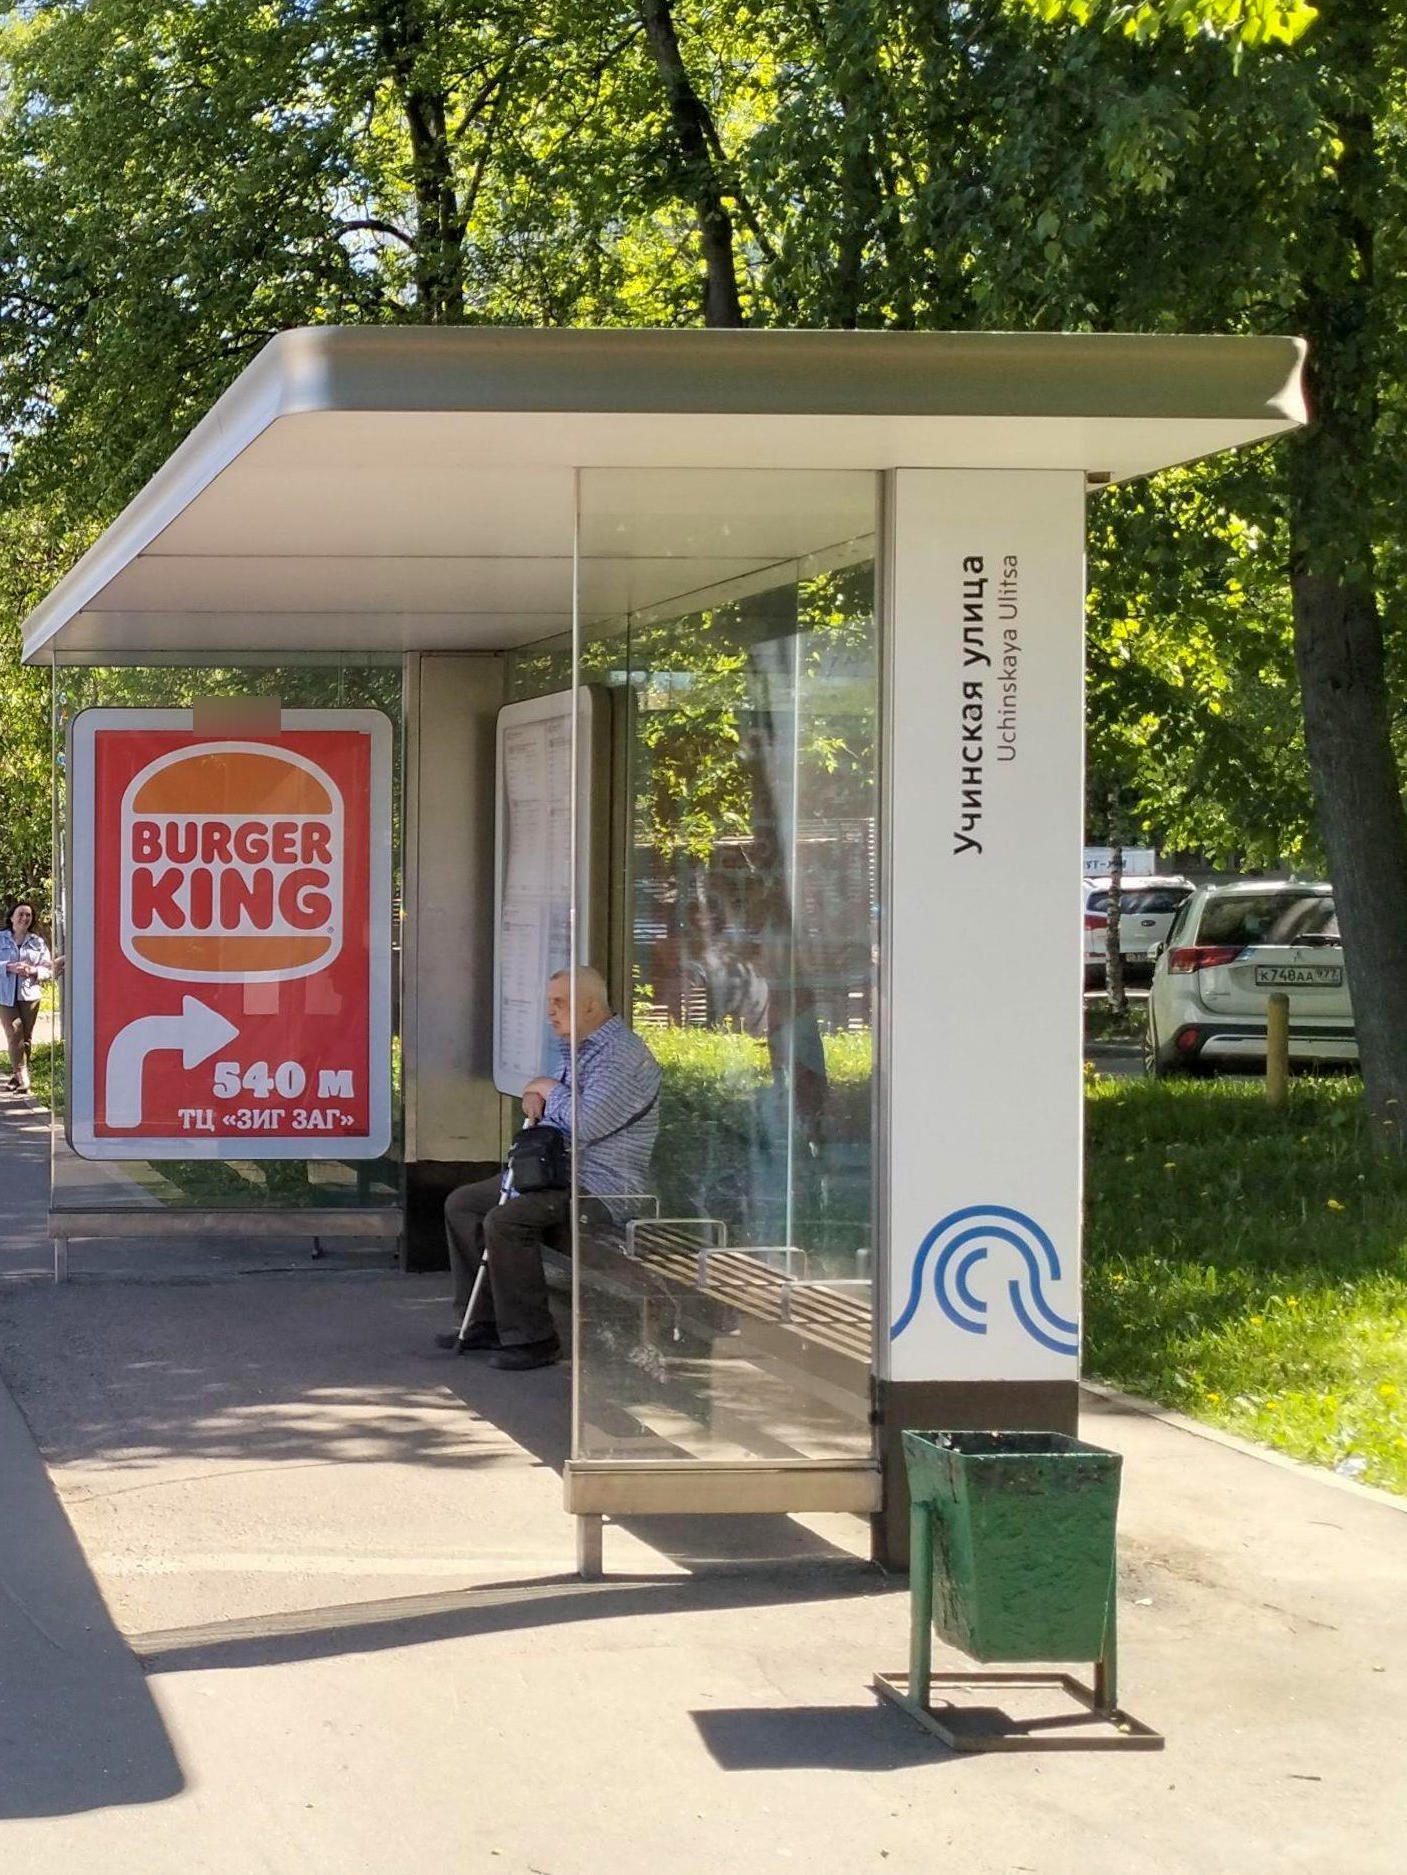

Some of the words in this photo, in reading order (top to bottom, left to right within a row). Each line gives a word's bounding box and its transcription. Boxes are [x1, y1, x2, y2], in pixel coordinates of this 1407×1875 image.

[962, 555, 991, 667] улица
[997, 555, 1018, 620] Ulitsa
[996, 628, 1022, 761] Uchinskaya
[953, 680, 983, 855] Учинская
[131, 821, 333, 865] BURGER
[131, 867, 333, 931] KING
[212, 1061, 306, 1099] 540
[178, 1109, 215, 1132] ТЦ
[222, 1108, 284, 1130] «ЗИГ
[292, 1108, 355, 1130] ЗАГ»
